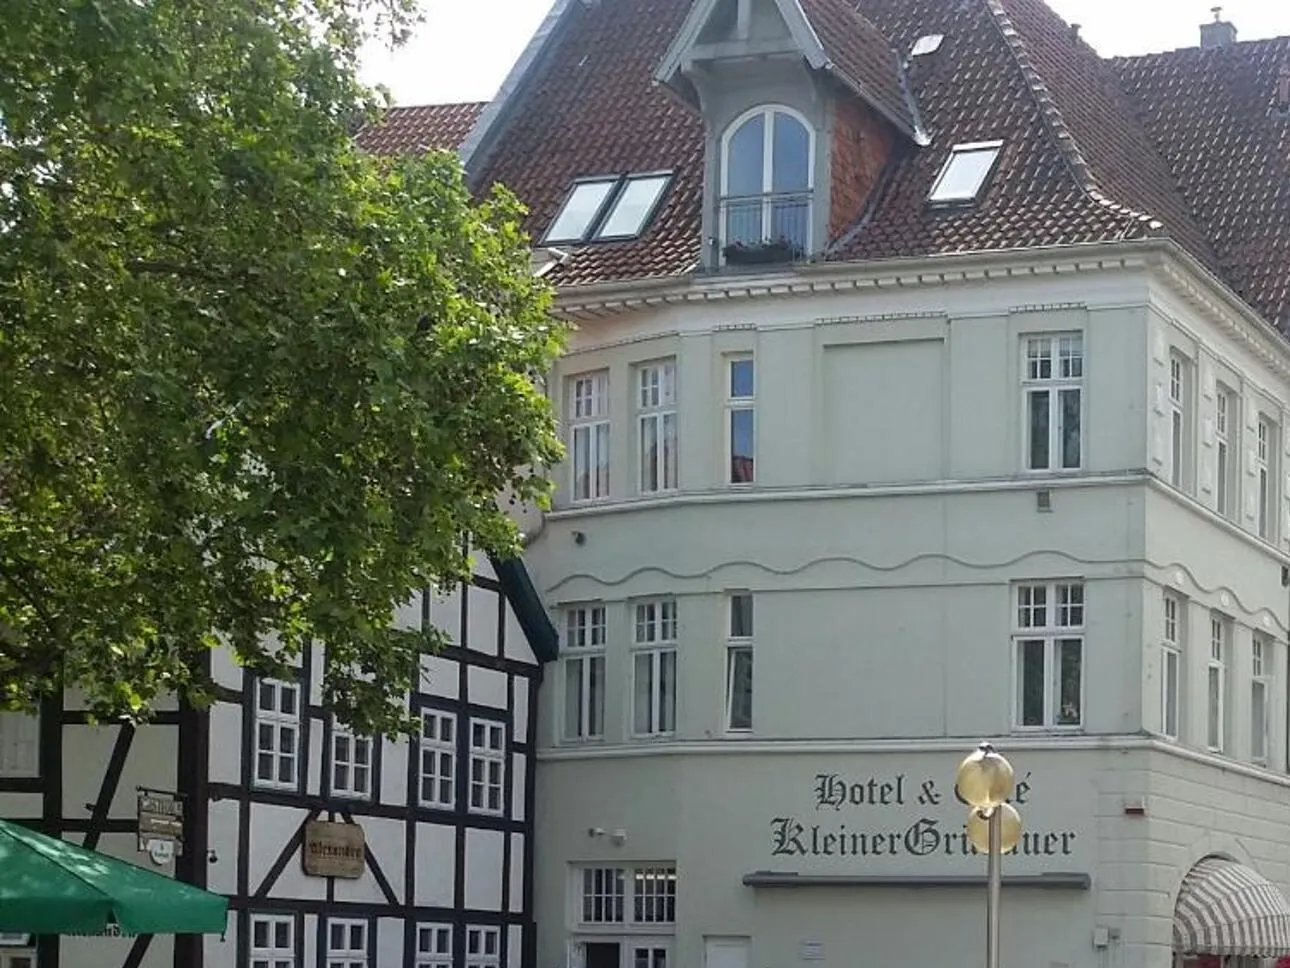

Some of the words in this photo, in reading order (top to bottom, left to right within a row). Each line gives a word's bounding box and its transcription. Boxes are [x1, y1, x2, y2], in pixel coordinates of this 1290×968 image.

[814, 773, 904, 811] Hotel
[918, 780, 942, 805] &
[904, 818, 1076, 857] Gruer
